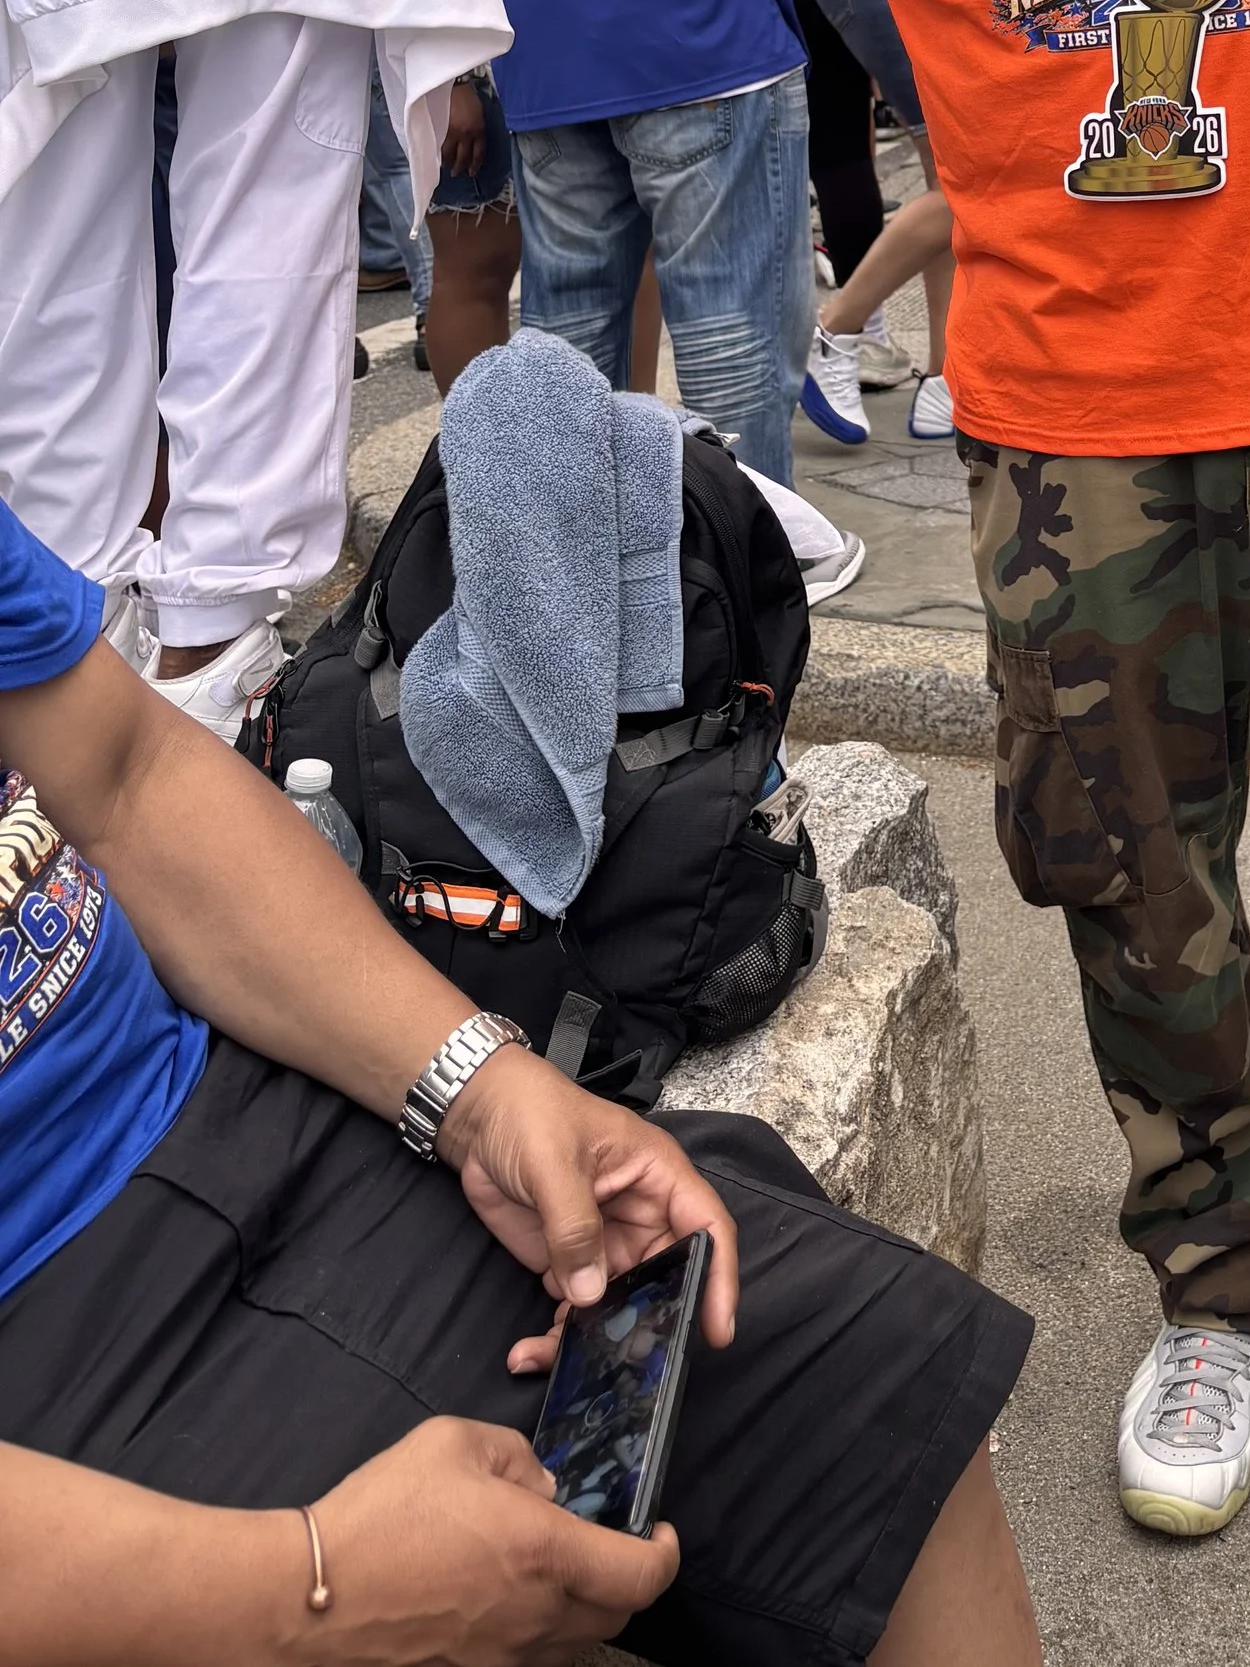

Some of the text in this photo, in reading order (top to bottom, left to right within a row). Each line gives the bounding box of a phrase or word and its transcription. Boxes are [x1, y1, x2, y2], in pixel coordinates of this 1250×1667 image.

[1058, 29, 1110, 48] FIRST
[1121, 103, 1187, 131] KNICKS
[1192, 116, 1219, 153] 26
[1088, 121, 1115, 159] 20
[79, 886, 102, 940] 1973
